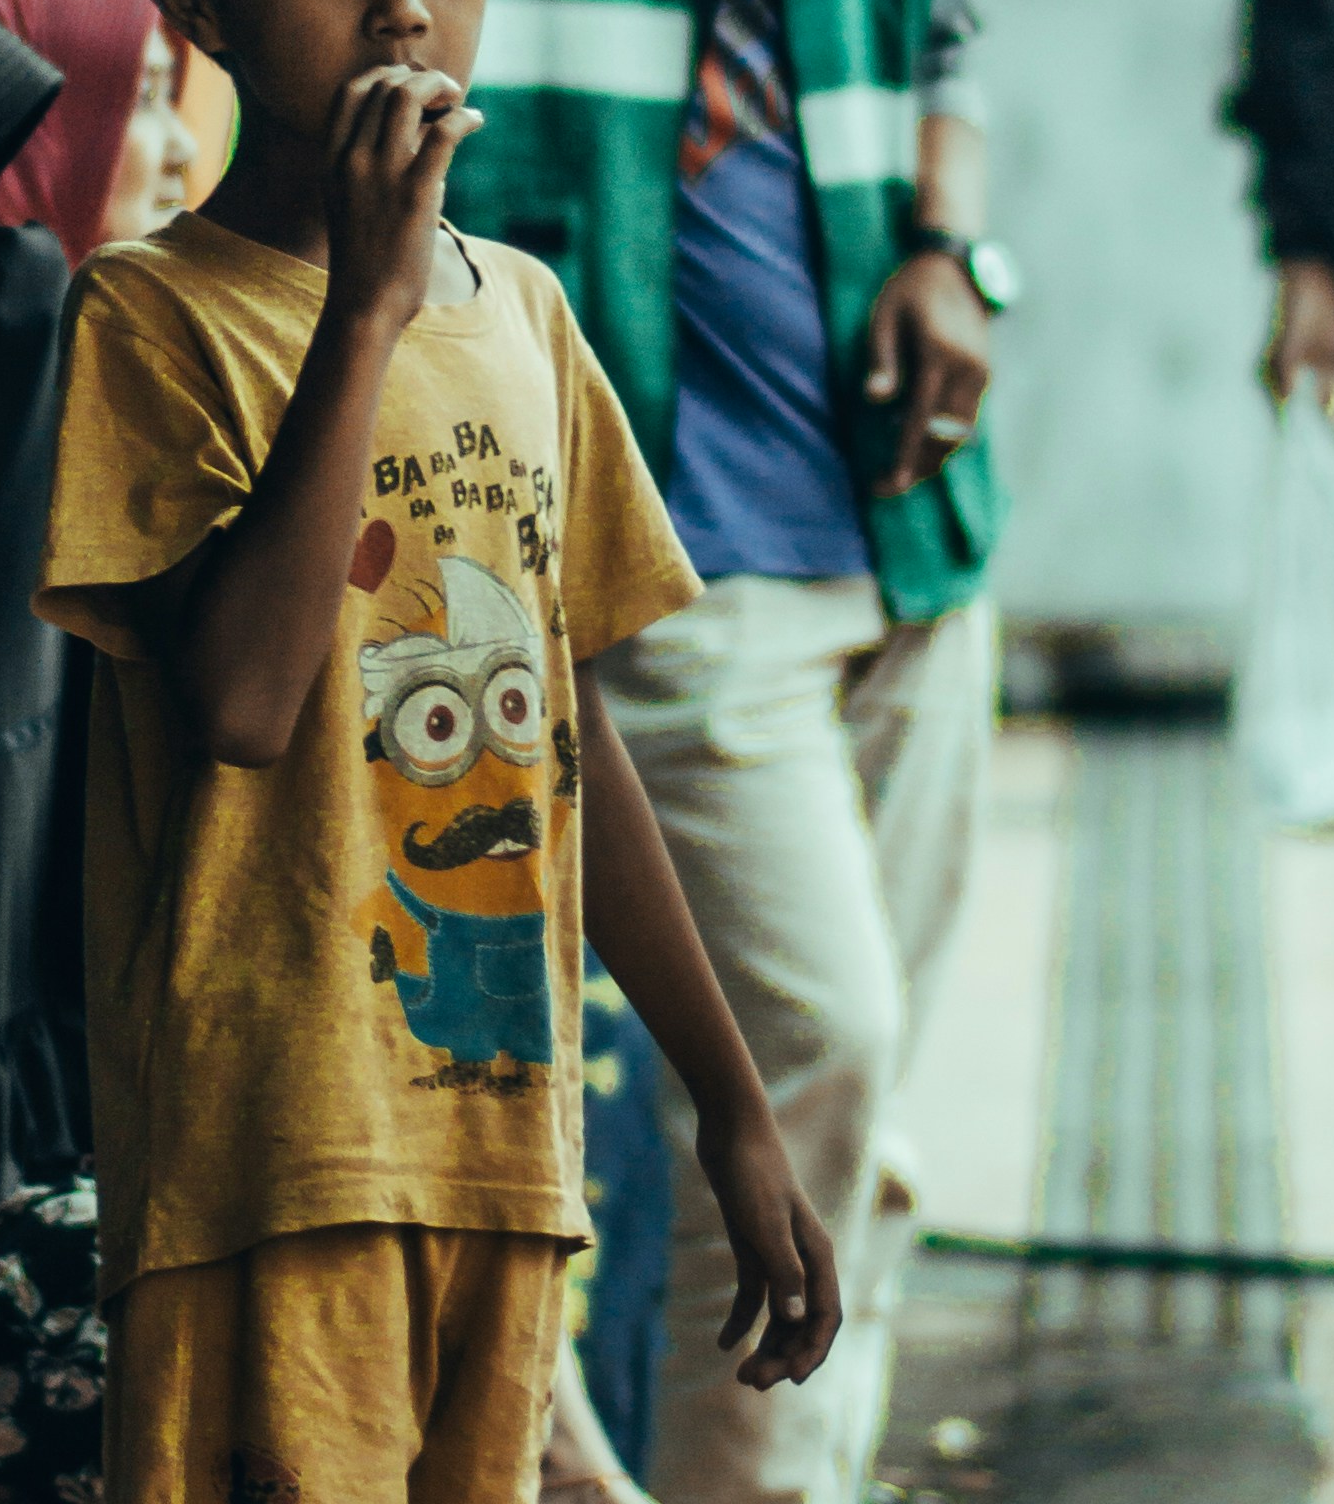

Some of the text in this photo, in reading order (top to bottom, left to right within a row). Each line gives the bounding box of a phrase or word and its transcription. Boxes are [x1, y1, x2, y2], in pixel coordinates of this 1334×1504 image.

[452, 420, 501, 460] BA
[372, 454, 427, 497] BA
[429, 451, 457, 475] BA
[451, 478, 518, 514] BA BA
